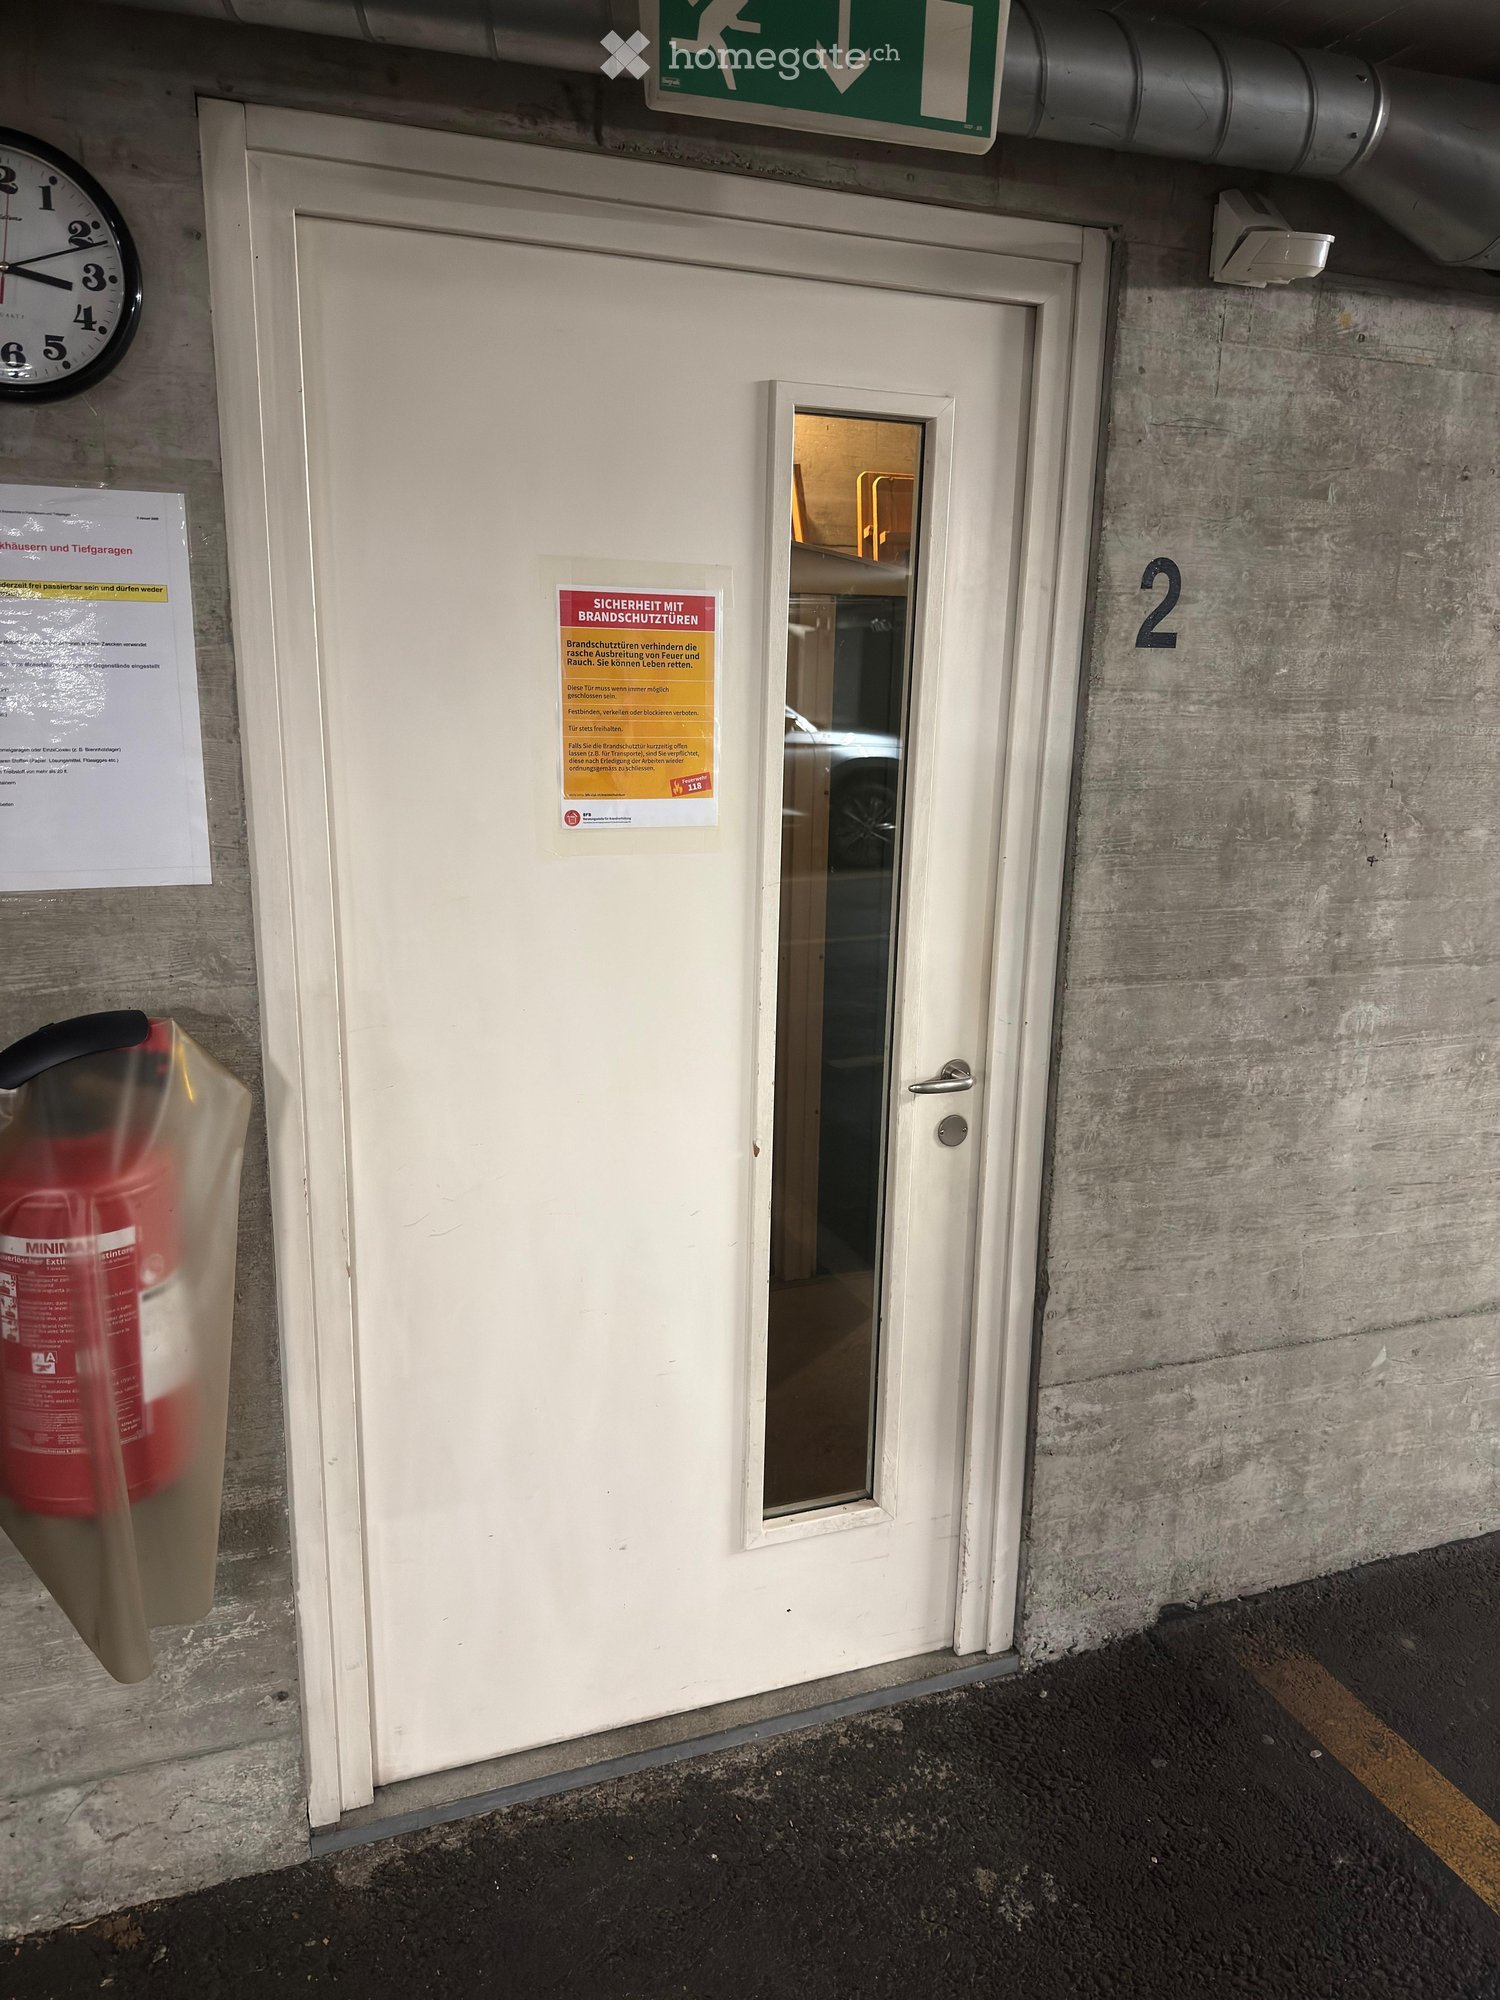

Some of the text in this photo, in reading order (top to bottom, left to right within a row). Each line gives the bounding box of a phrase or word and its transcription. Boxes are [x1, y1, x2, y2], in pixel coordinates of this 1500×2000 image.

[38, 185, 56, 211] 1
[68, 219, 94, 248] 2
[82, 263, 108, 292] 3
[73, 303, 98, 332] 4
[43, 334, 67, 361] 5
[1, 341, 27, 368] 6
[50, 544, 69, 552] und
[71, 545, 133, 556] Tiefgaragen
[43, 583, 82, 591] passierbar
[594, 598, 684, 613] SICHERHEIT MIT
[1136, 557, 1181, 648] 2
[578, 611, 698, 625] BRANDSCHUTZTÜREN
[566, 640, 697, 652] Brandschutztüren verhindern die
[567, 649, 594, 658] rasche
[595, 650, 643, 661] Ausbreitung
[661, 652, 683, 660] Feuer
[685, 652, 700, 660] und
[567, 658, 693, 669] Rauch. Sie können Leben retten.
[567, 692, 603, 700] geschlossen
[647, 686, 670, 694] möglich
[568, 709, 602, 717] Festbinden,
[673, 709, 699, 717] verboten.
[647, 743, 673, 751] kurzzeitig
[568, 757, 585, 765] diese
[600, 758, 631, 766] Erledigung
[568, 765, 618, 773] ordnungsgemäss
[626, 765, 656, 773] schliessen.
[681, 775, 708, 785] Feuerwehr
[687, 782, 702, 793] 118
[46, 1352, 56, 1362] A
